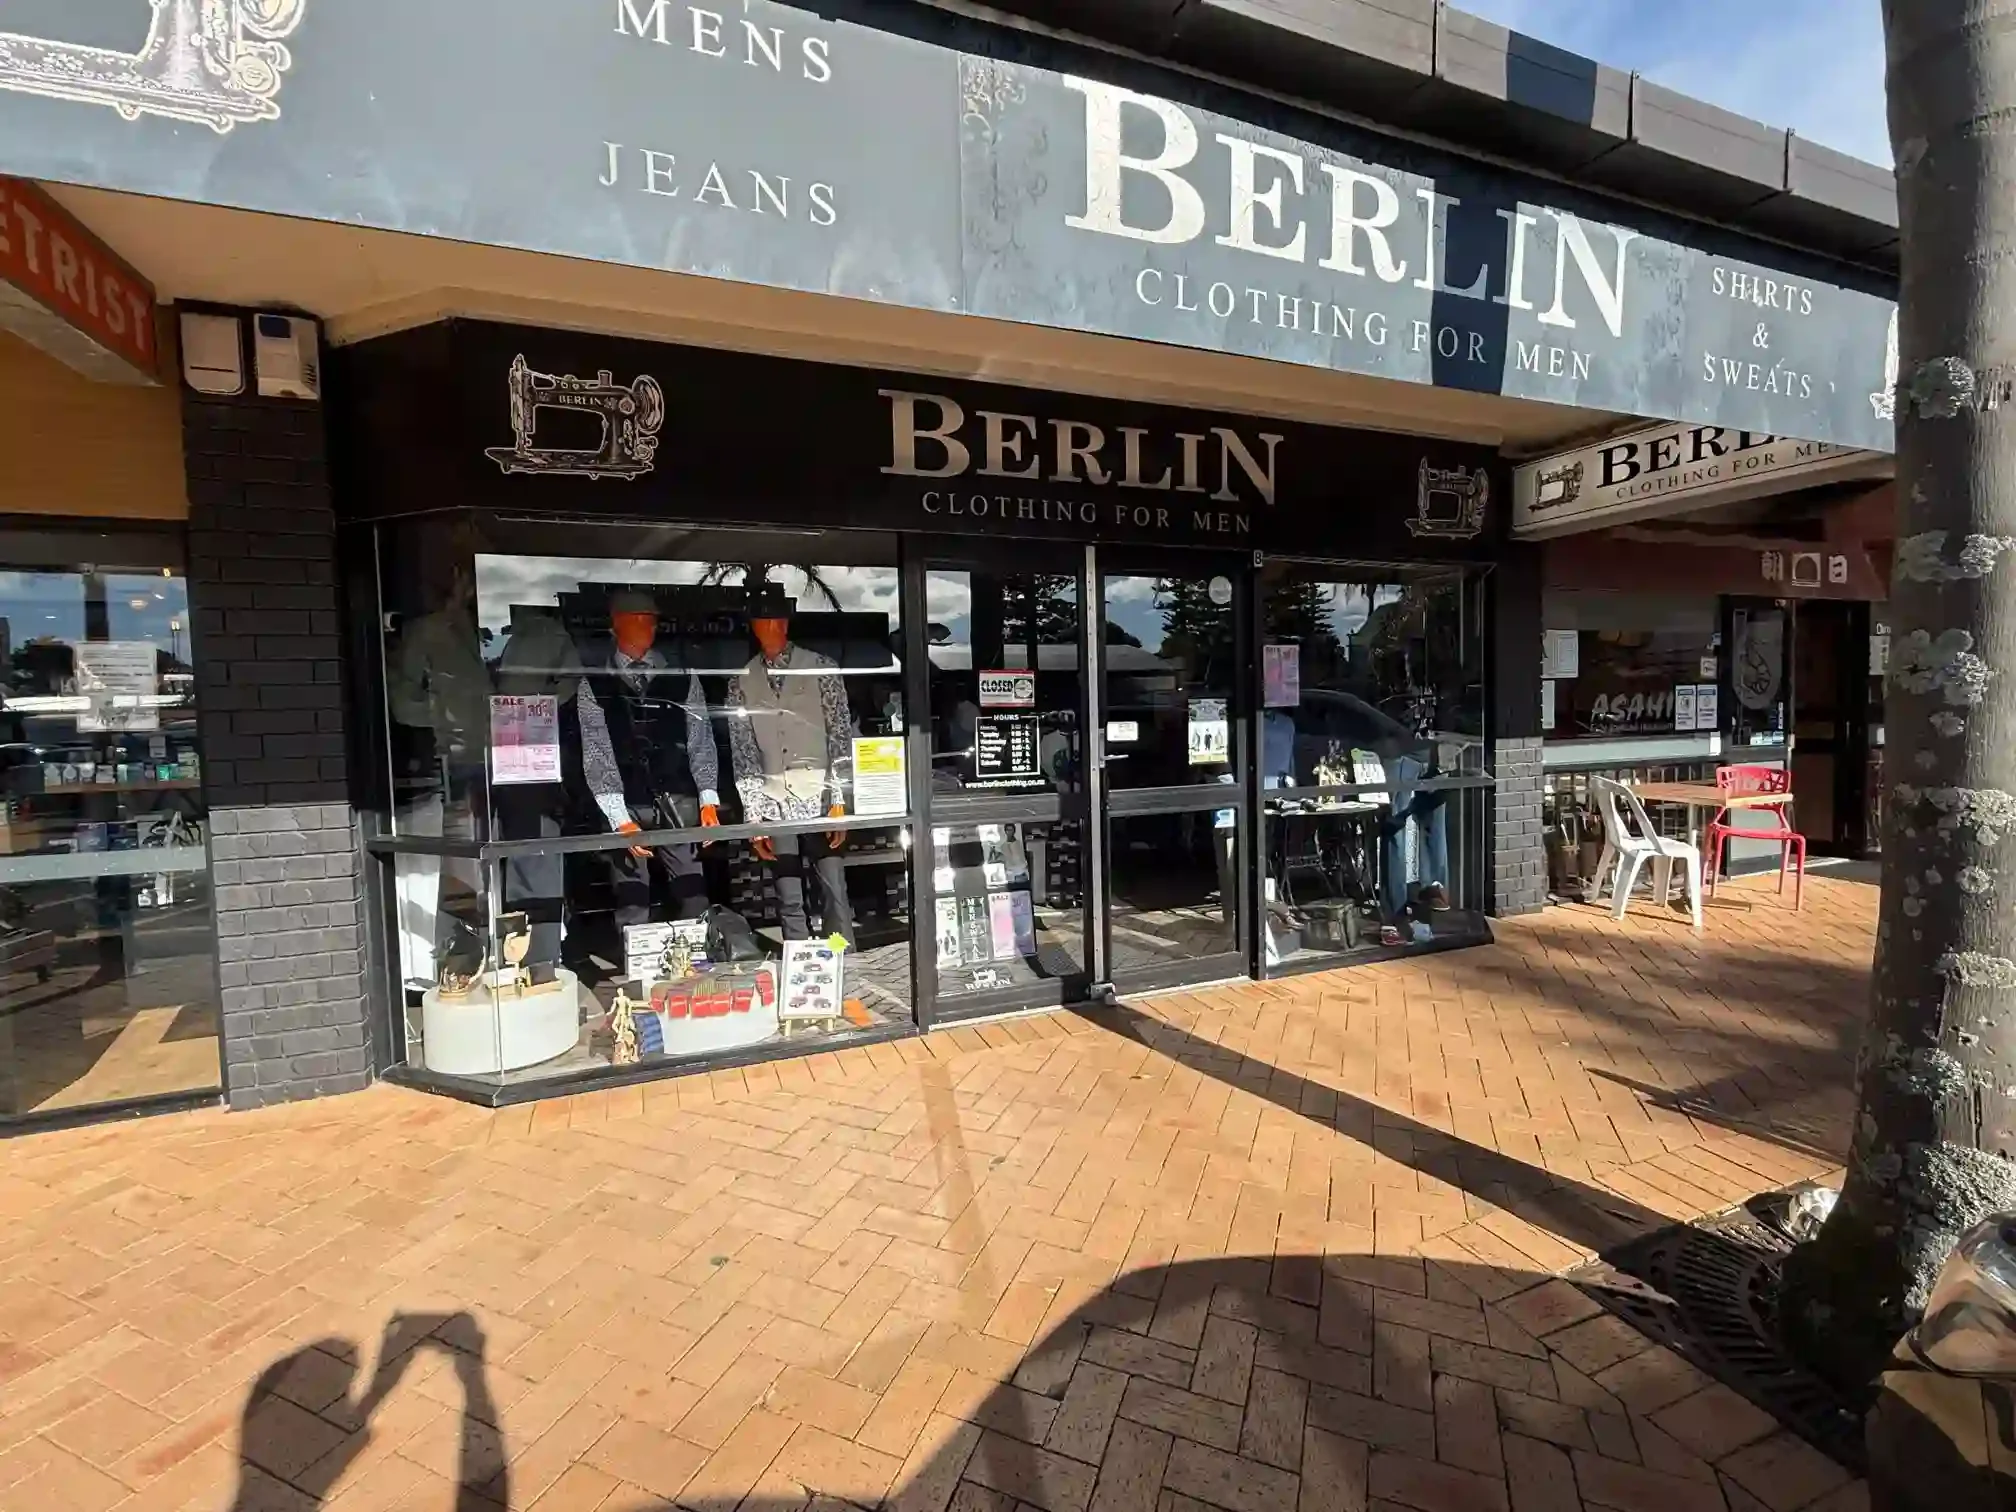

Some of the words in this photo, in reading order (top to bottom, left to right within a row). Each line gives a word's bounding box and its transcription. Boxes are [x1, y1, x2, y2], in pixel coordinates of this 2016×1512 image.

[614, 0, 831, 83] MENS
[598, 141, 836, 226] JEANS
[1064, 73, 1638, 337] BERLIN
[1712, 267, 1812, 315] SHIRTS
[1135, 268, 1388, 346] CLOTHING
[1412, 319, 1487, 364] FOR
[1515, 339, 1591, 382] MEN
[1752, 322, 1769, 349] &
[1703, 353, 1811, 398] SWEATS
[877, 388, 1285, 505] BERLIN
[1596, 426, 1788, 489] BERL
[1615, 465, 1720, 499] CLOTHING
[1732, 452, 1776, 473] FOR
[1795, 442, 1848, 460] ME
[921, 491, 1096, 523] CLOTHING
[1115, 504, 1170, 528] FOR
[1192, 510, 1251, 533] MEN
[494, 697, 525, 706] SALE
[980, 680, 1013, 693] CLOSED
[1590, 692, 1674, 727] ASAHI
